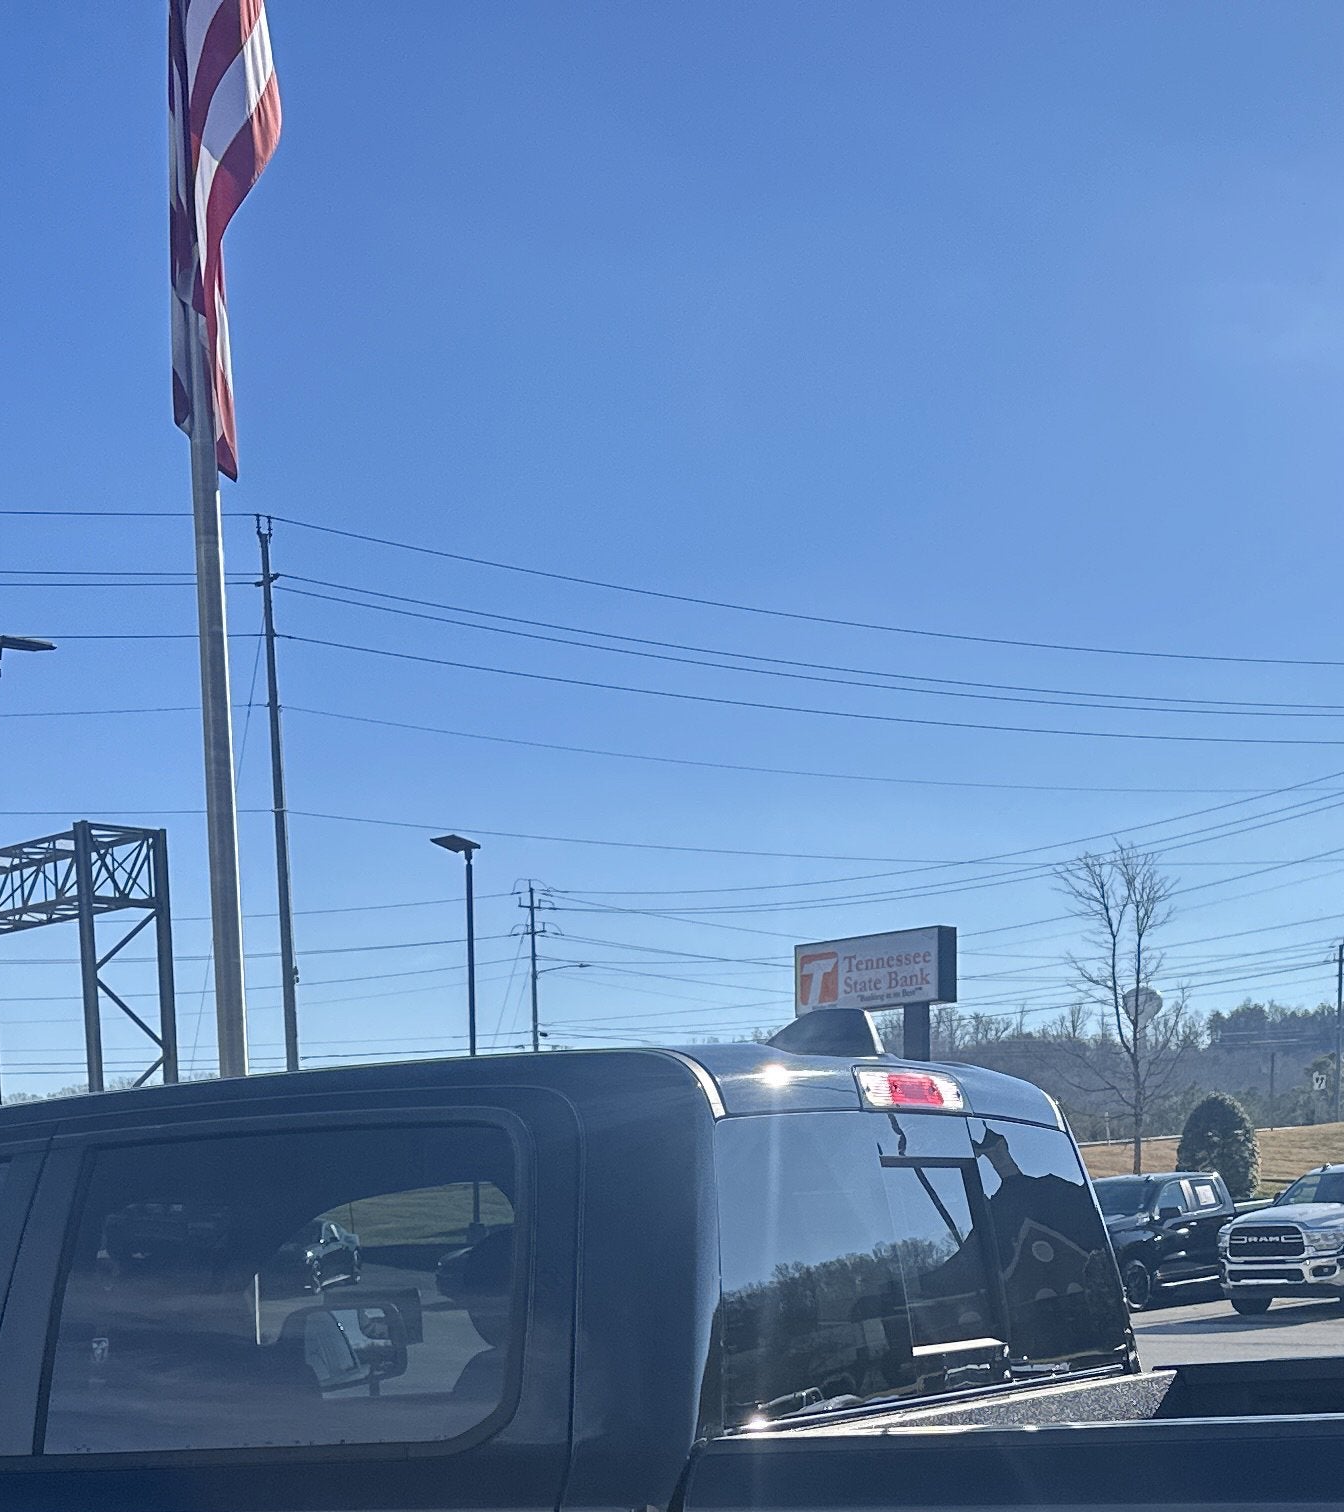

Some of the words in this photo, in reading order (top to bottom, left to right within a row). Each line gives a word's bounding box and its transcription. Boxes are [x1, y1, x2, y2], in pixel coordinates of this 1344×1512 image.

[843, 951, 932, 973] Tennessee
[843, 976, 882, 995] State
[887, 968, 931, 989] Bank
